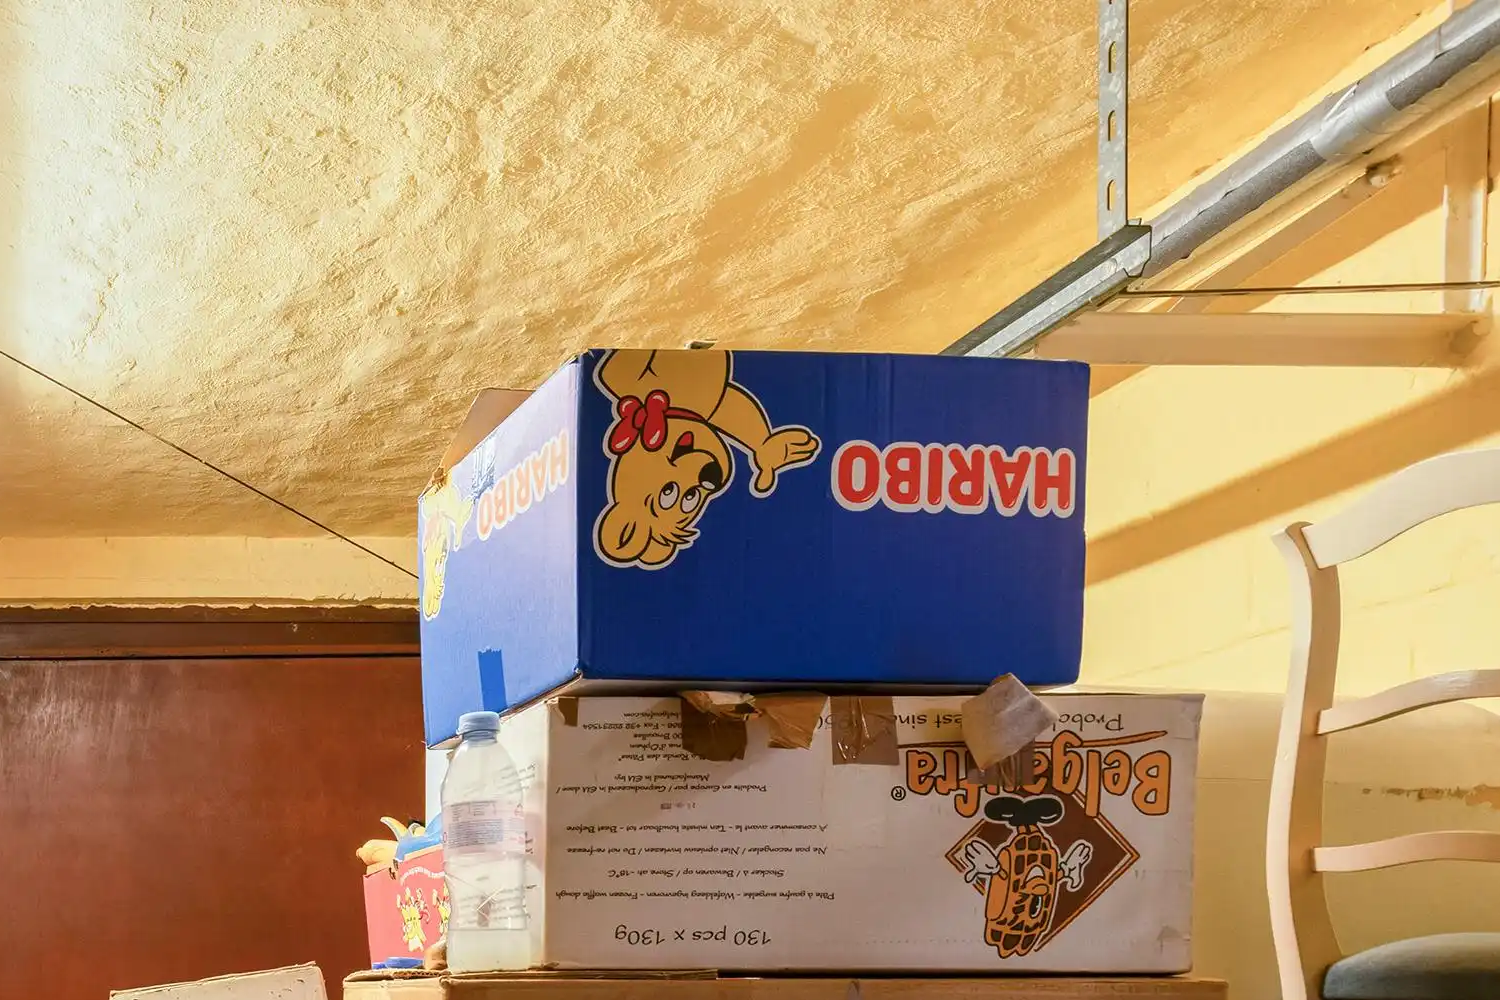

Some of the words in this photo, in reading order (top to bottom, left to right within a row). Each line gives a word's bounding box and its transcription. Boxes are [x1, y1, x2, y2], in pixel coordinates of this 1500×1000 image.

[833, 442, 1074, 515] HARIBO
[477, 429, 568, 540] HARIBO
[644, 722, 659, 730] Fax
[654, 772, 710, 782] Manufactured
[906, 731, 1171, 818] Belgafra
[562, 785, 581, 793] door
[582, 785, 597, 793] EU
[608, 783, 666, 793] Geproduceerd
[674, 783, 688, 792] par
[690, 783, 720, 793] Europe
[734, 784, 767, 792] Produits
[566, 824, 596, 833] Before
[597, 825, 618, 833] Best
[639, 825, 680, 833] houdbaar
[681, 824, 708, 832] minste
[710, 825, 726, 833] Ten
[735, 825, 742, 833] le
[623, 848, 636, 856] Do
[644, 847, 682, 855] invriezen
[684, 845, 719, 854] opnieuw
[720, 846, 740, 855] Niet
[748, 845, 793, 855] recongeler
[795, 846, 811, 854] pas
[813, 847, 827, 855] Ne
[650, 870, 674, 878] Store
[683, 868, 693, 876] op
[695, 869, 734, 878] Bewaren
[751, 869, 785, 878] Stocker
[555, 890, 581, 900] dough
[583, 890, 607, 900] waffle
[609, 891, 638, 900] Frozen
[646, 890, 689, 899] ingevroren
[691, 890, 735, 900] Wafeldeeg
[743, 891, 777, 900] surgelée
[779, 890, 806, 900] gaufre
[806, 892, 814, 900] à
[816, 892, 835, 900] Pâte
[614, 924, 666, 946] 130g
[674, 930, 685, 941] x
[692, 925, 727, 943] pcs
[733, 930, 772, 945] 130
